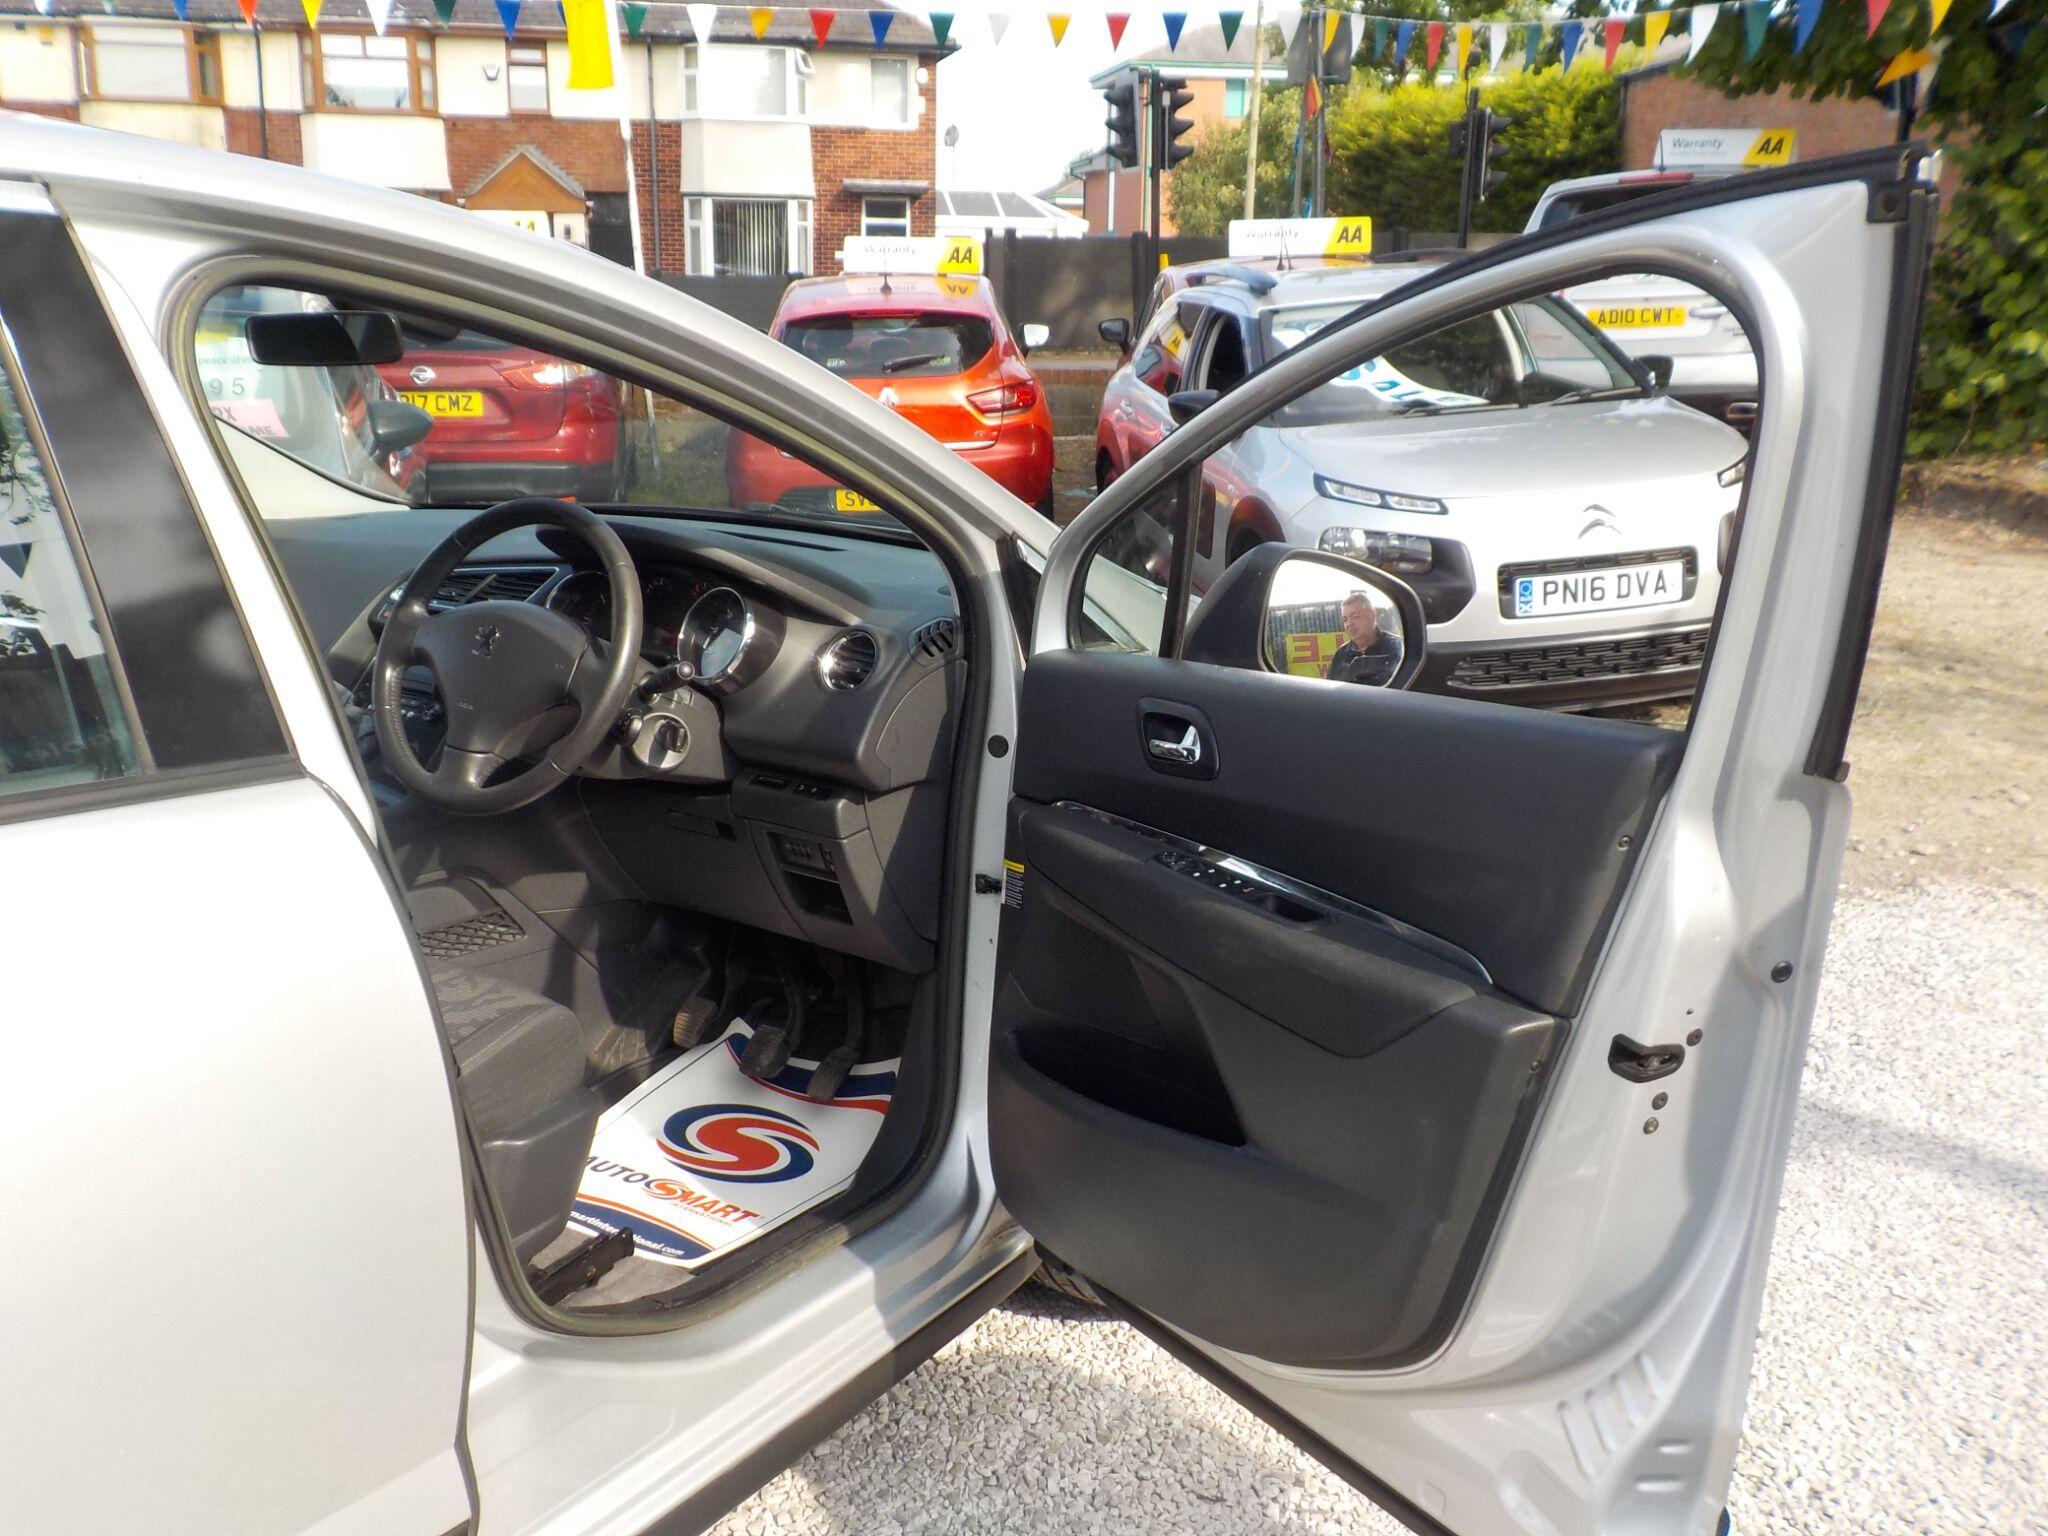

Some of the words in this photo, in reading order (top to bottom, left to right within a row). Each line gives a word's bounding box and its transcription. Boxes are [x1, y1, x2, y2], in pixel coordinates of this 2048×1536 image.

[1671, 137, 1725, 150] Warranty
[1756, 136, 1785, 155] AA
[1336, 225, 1363, 244] AA
[947, 246, 974, 264] AA
[1640, 306, 1675, 323] CWT
[435, 394, 473, 412] CMZ
[844, 491, 877, 507] SV
[1542, 576, 1606, 606] PN16
[1616, 569, 1668, 600] DVA
